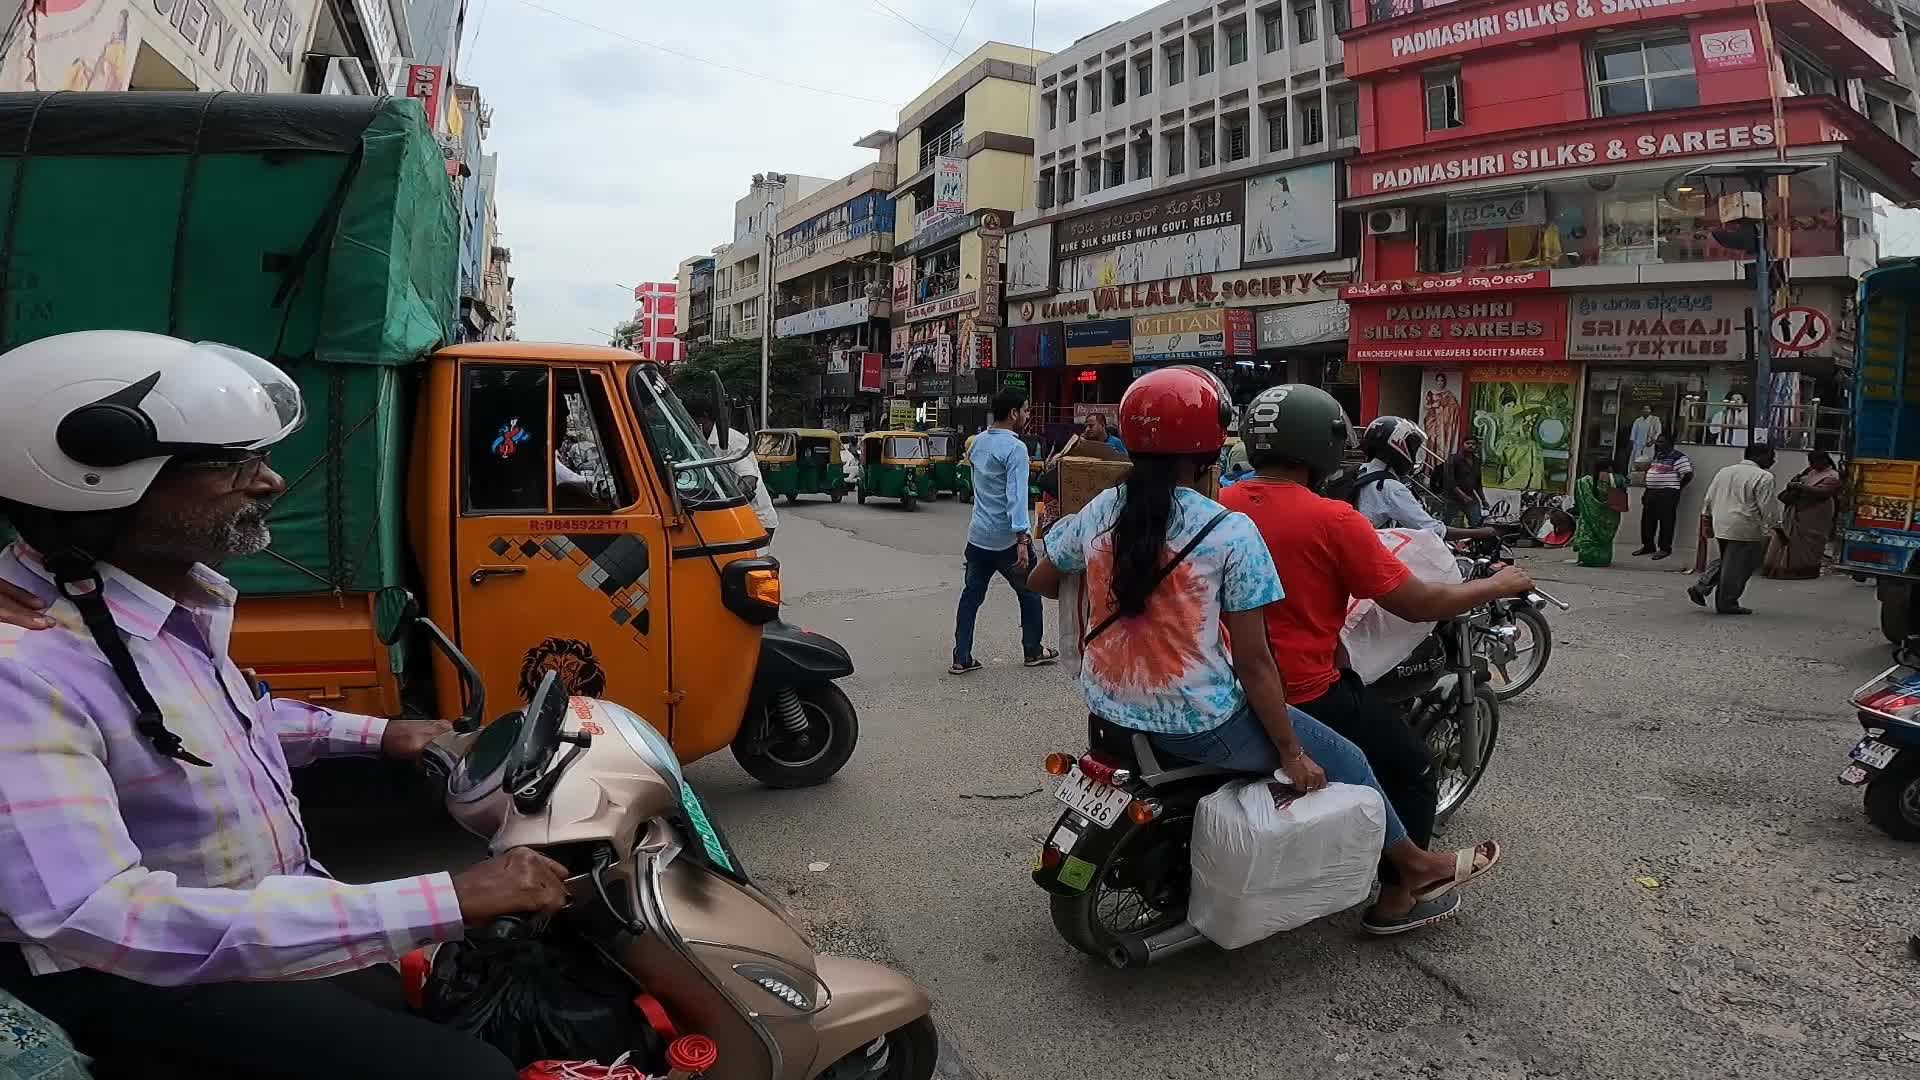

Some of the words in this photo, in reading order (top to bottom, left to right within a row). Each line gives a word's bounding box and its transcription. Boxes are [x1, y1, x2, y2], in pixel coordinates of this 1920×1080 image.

[1392, 20, 1500, 57] PADMASHRI
[1505, 1, 1570, 31] SILKS
[1372, 153, 1505, 190] PADMASHRI
[1512, 142, 1596, 169] SILKS
[1606, 139, 1627, 160] &
[1637, 124, 1775, 155] SAREES
[1060, 243, 1079, 253] PURE
[1081, 238, 1098, 249] SILK
[1102, 230, 1132, 245] SAREES
[1135, 226, 1158, 238] WITH
[1161, 219, 1189, 233] GOVT.
[1193, 211, 1233, 227] REBATE
[1093, 275, 1219, 311] VALLALAR
[1221, 274, 1313, 299] SOCIETY
[1386, 302, 1513, 321] PADMASHRI
[1152, 312, 1220, 333] TITAN
[1363, 324, 1422, 340] SILKS
[1428, 324, 1442, 338] &
[1450, 320, 1543, 338] SAREES
[1581, 320, 1621, 337] SRI
[1627, 318, 1731, 336] MAGAJI
[1357, 349, 1414, 358] KANCHEEPURAM
[1415, 348, 1432, 357] SILK
[1434, 348, 1471, 357] WEAVERS
[1473, 348, 1508, 357] SOCIETY
[1509, 347, 1545, 356] SAREES
[1625, 340, 1728, 356] TEXTILES
[1076, 775, 1093, 794] KA
[1076, 792, 1112, 822] 1486
